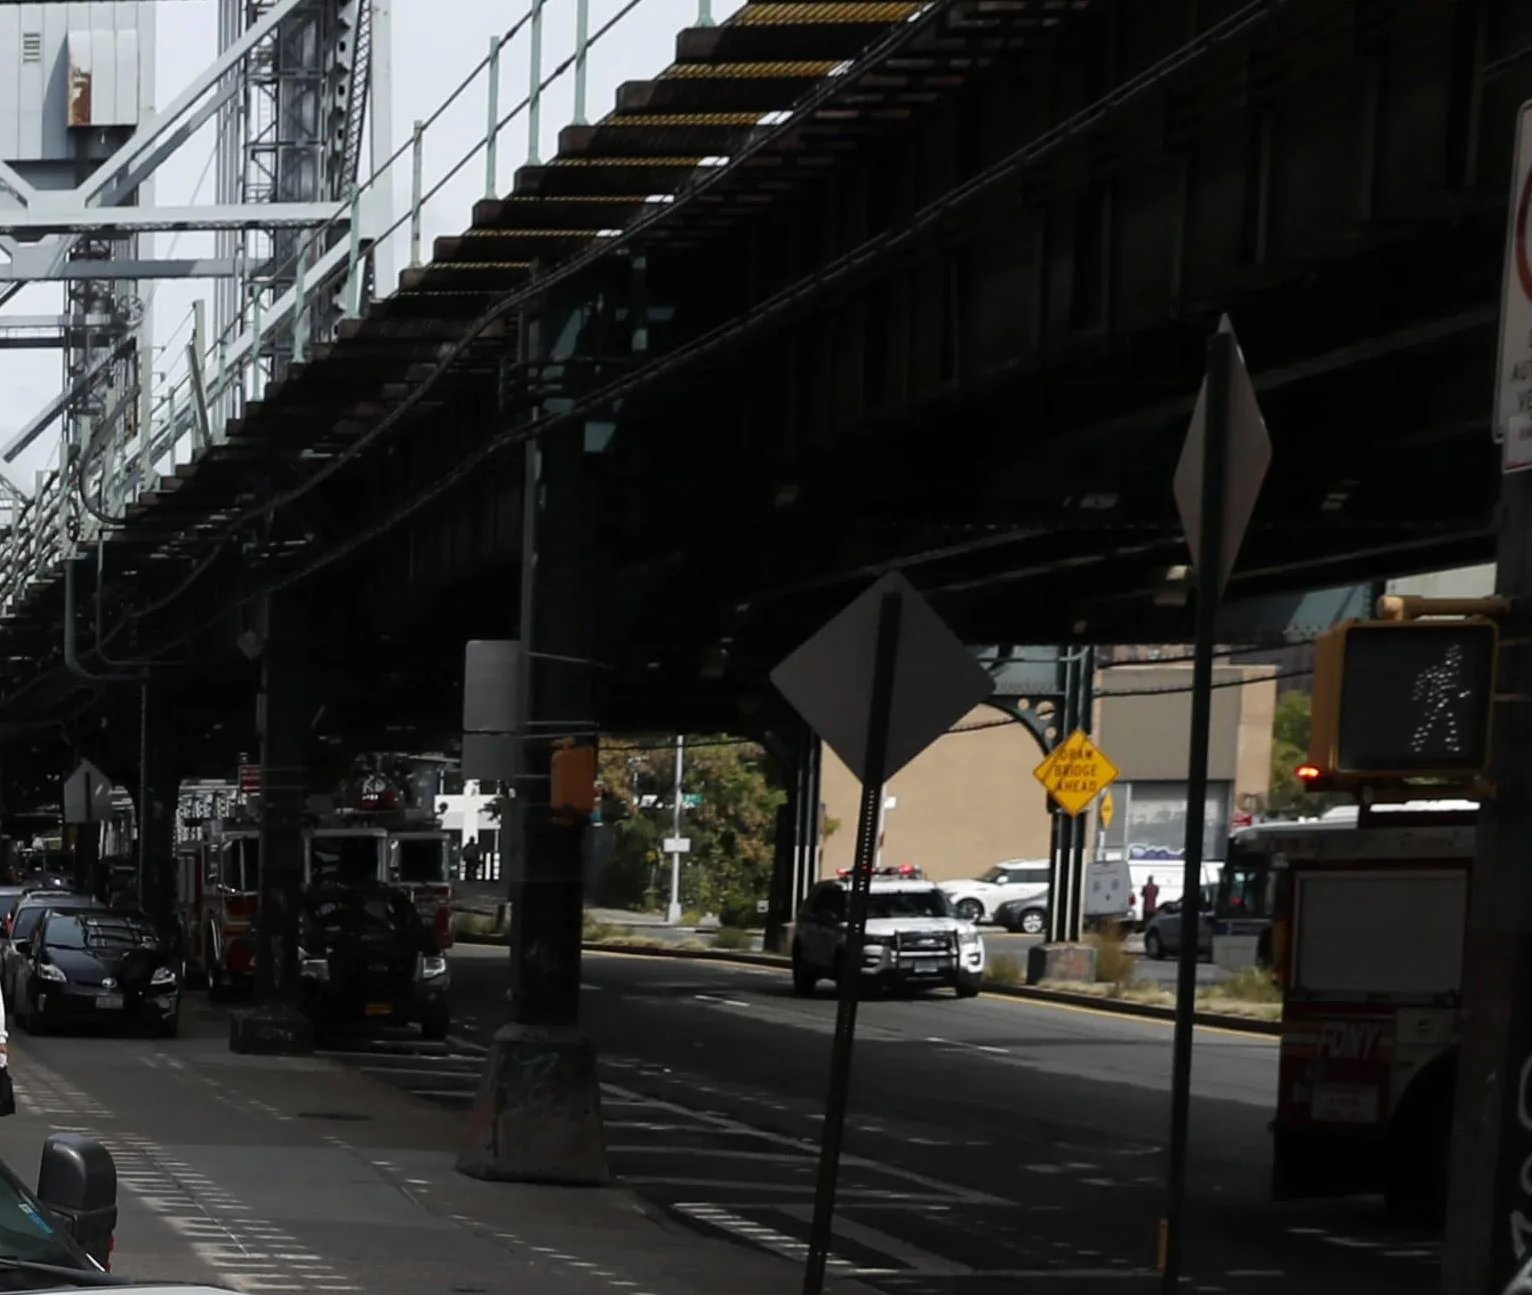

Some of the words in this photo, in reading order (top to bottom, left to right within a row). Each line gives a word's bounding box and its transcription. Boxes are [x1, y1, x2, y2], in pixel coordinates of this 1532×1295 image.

[1054, 764, 1098, 777] BRIDGE
[1055, 780, 1098, 793] AHEAD
[1319, 1020, 1383, 1062] FDNY
